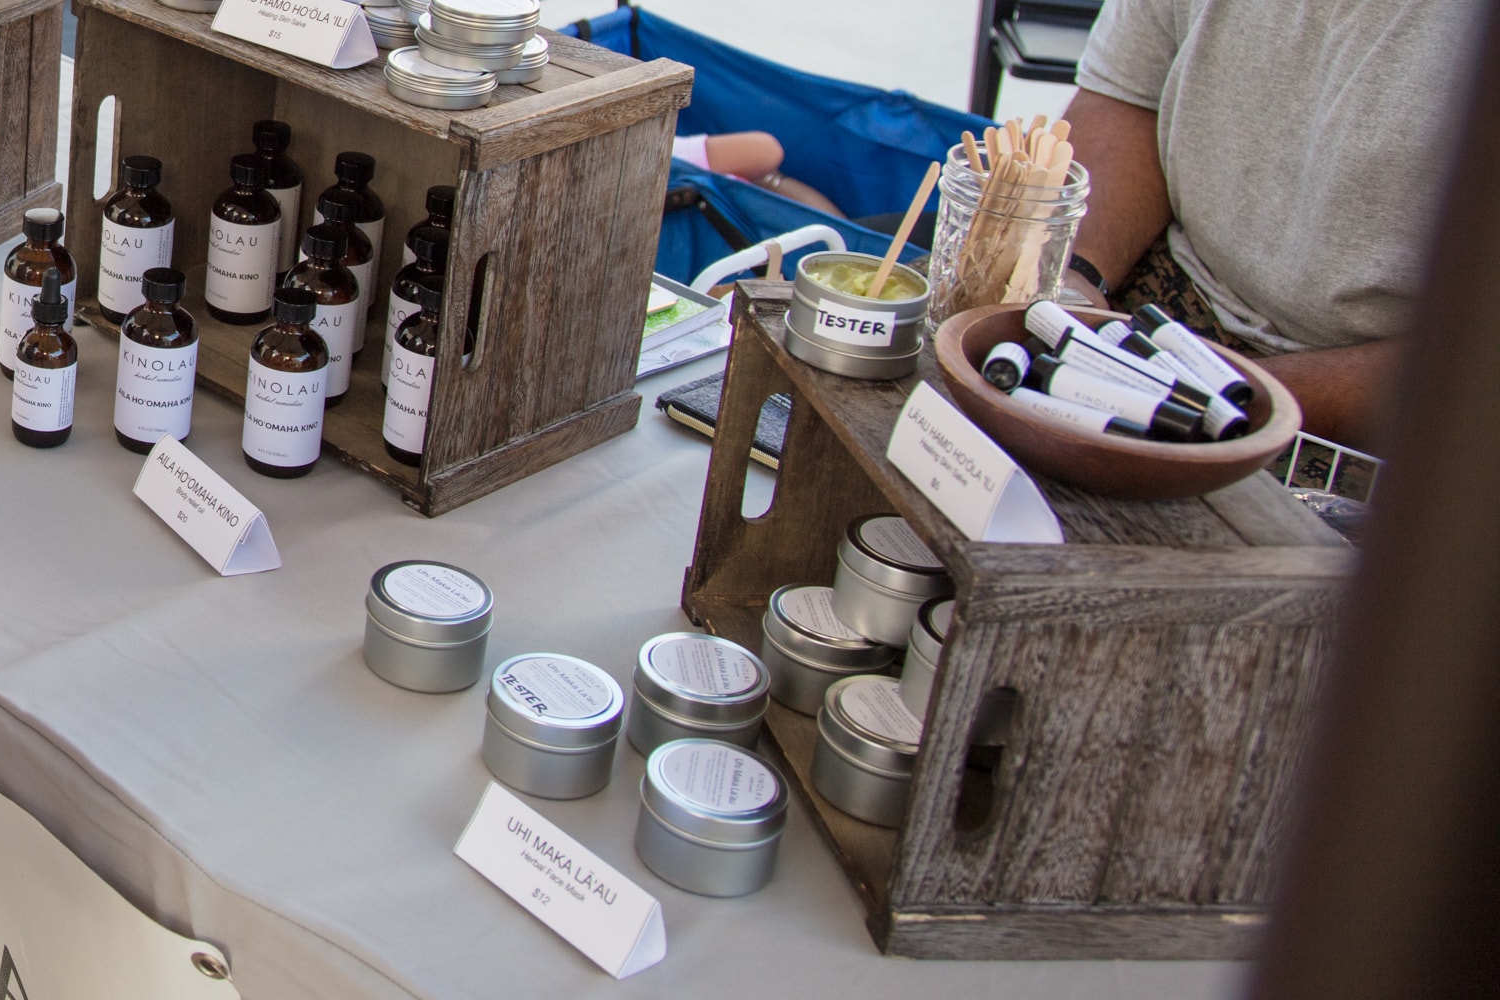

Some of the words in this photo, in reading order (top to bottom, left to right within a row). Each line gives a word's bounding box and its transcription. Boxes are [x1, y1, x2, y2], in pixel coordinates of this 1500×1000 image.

[257, 9, 279, 21] Healing
[278, 14, 291, 24] Skin
[290, 18, 307, 28] Salve
[268, 29, 282, 40] $15
[104, 229, 144, 249] OLAU
[239, 273, 260, 281] KINO
[817, 309, 887, 336] TESTER
[123, 349, 195, 372] KINOLAU
[131, 395, 179, 408] HO'OMAHA
[1075, 391, 1126, 415] KINOLAU
[418, 408, 428, 418] KI
[1032, 402, 1082, 423] KINOLAU
[253, 417, 300, 433] HO'OMAHA
[300, 421, 319, 432] KINO
[929, 426, 954, 453] HAMO
[156, 452, 176, 473] AILA
[174, 466, 219, 510] HO'OMAHA
[215, 503, 239, 528] KINO
[176, 486, 188, 501] Body
[187, 497, 201, 509] relief
[197, 506, 206, 515] oil
[177, 510, 189, 524] $20
[429, 576, 451, 591] Maka
[559, 672, 578, 691] Maka
[502, 673, 549, 714] TESTER
[507, 816, 533, 843] UHI
[532, 835, 574, 875] MAKA
[520, 849, 547, 873] Herbal
[545, 868, 565, 888] Face
[564, 882, 587, 904] Mask
[531, 887, 553, 907] $12
